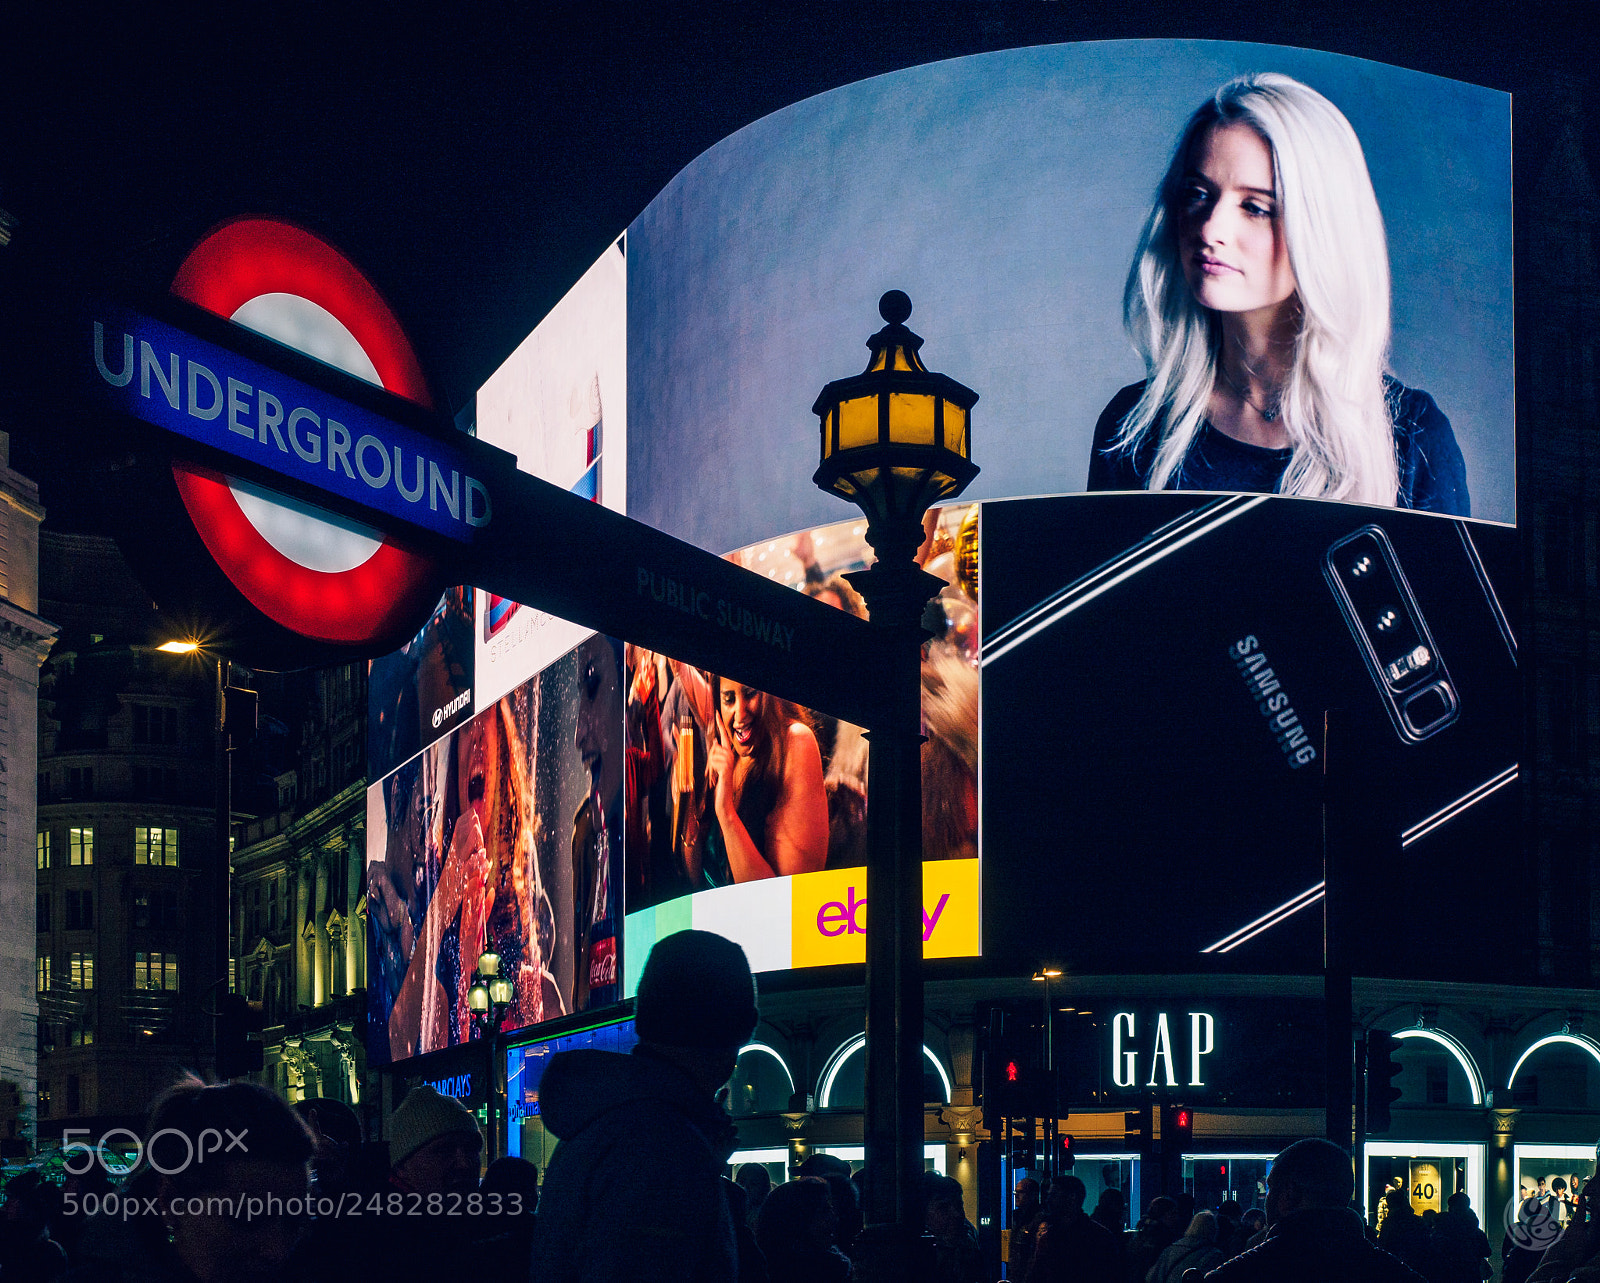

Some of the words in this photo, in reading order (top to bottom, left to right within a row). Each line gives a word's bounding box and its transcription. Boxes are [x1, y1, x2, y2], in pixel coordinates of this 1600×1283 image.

[93, 320, 493, 529] UNDERGROUND
[635, 566, 711, 620] PUBLIC
[715, 597, 796, 653] SUBWAY
[443, 688, 471, 721] HYUNDAI
[1234, 634, 1317, 766] SAMSUNG
[816, 886, 951, 942] eby
[1112, 1012, 1214, 1087] GAP
[1412, 1183, 1435, 1200] 40
